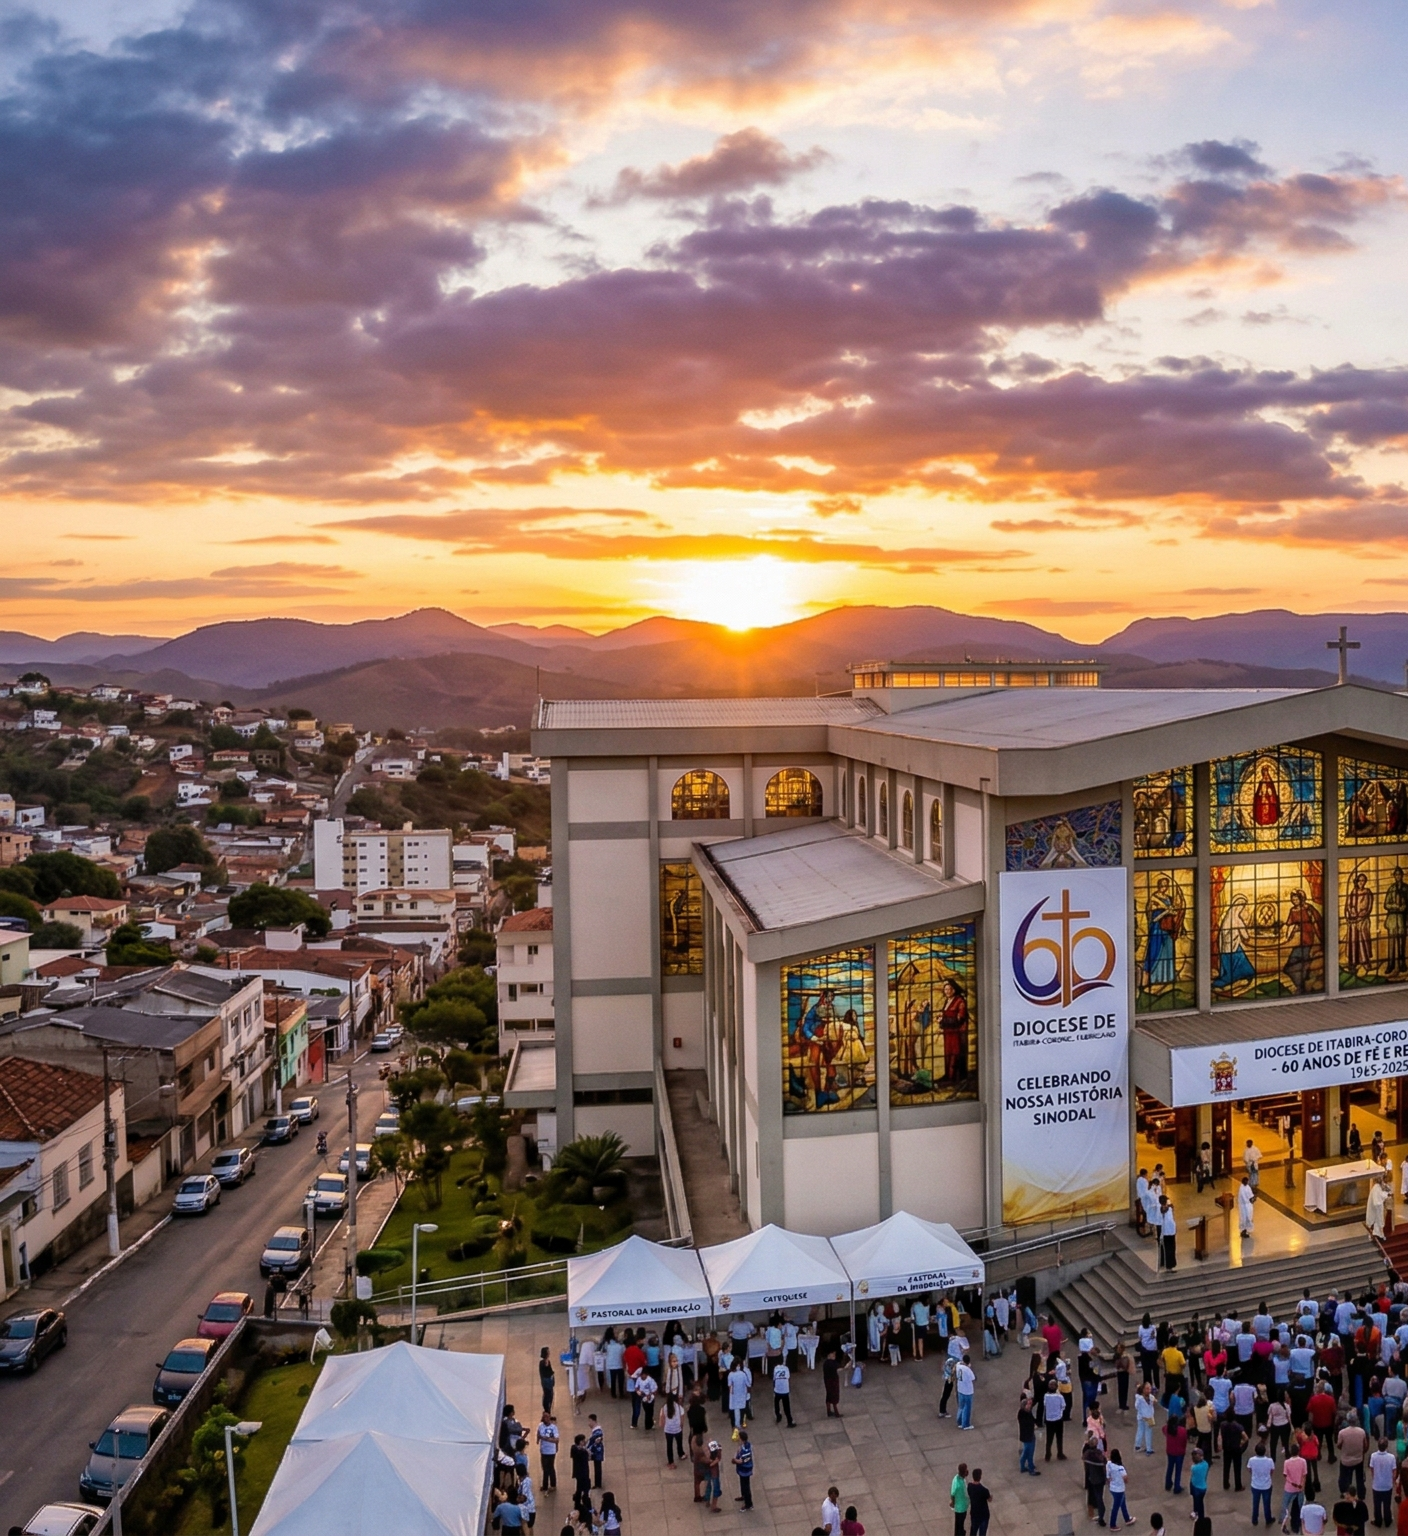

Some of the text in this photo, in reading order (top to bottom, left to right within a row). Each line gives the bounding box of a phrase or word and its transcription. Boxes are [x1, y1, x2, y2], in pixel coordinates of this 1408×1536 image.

[1013, 1016, 1088, 1036] DIOCESE
[1094, 1013, 1116, 1029] DE
[1255, 1043, 1305, 1060] DIOCESE
[1308, 1041, 1324, 1053] DE
[1281, 1060, 1299, 1074] 60
[1302, 1054, 1341, 1072] ANOS
[1344, 1051, 1362, 1065] DE
[1383, 1047, 1391, 1059] E
[1017, 1070, 1111, 1091] CELEBRANDO
[1006, 1085, 1123, 1110] NOSSA HISTÓRIA
[1033, 1107, 1096, 1125] SINODAL
[591, 1309, 635, 1318] PASTORAL
[636, 1308, 648, 1316] DA
